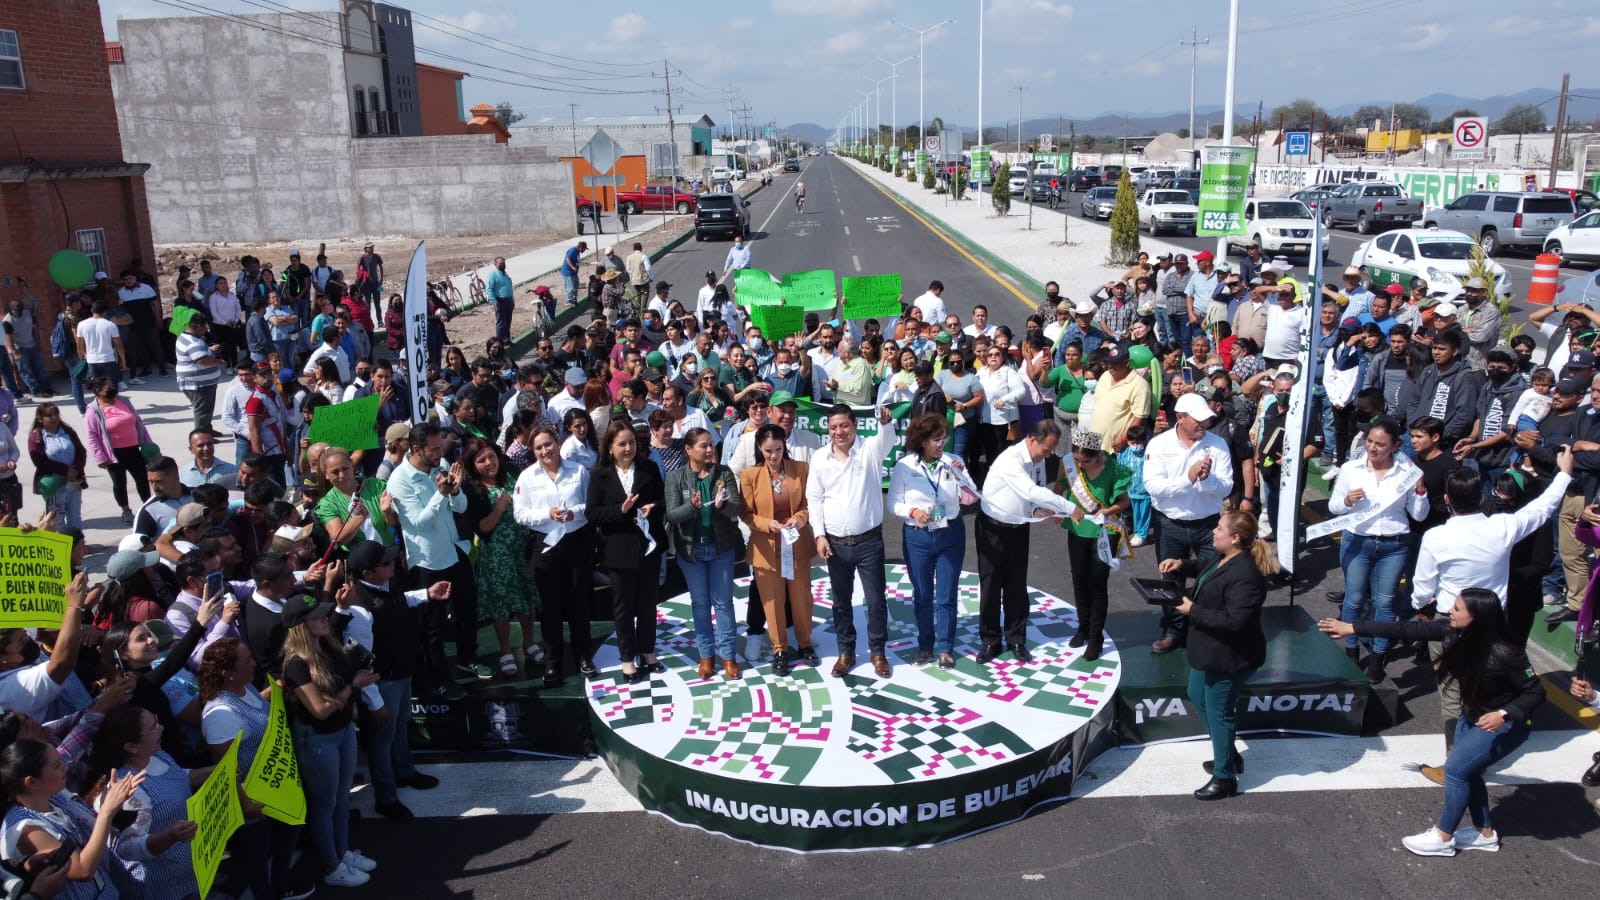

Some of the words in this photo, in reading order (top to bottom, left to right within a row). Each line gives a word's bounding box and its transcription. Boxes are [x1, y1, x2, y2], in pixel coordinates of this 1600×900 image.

[1394, 172, 1478, 206] VERDE
[1203, 220, 1241, 231] NOTA
[8, 545, 55, 561] DOCENTES
[6, 580, 36, 594] BUEN
[2, 598, 17, 612] DE
[19, 598, 64, 614] GALLARDO!
[411, 704, 449, 714] UVOP
[1135, 697, 1187, 724] ¡YA
[1247, 693, 1354, 712] NOTA!
[269, 767, 286, 789] LOS
[685, 788, 908, 829] INAUGURACIÓN
[917, 798, 956, 823] DE
[964, 756, 1073, 814] BULEVAR
